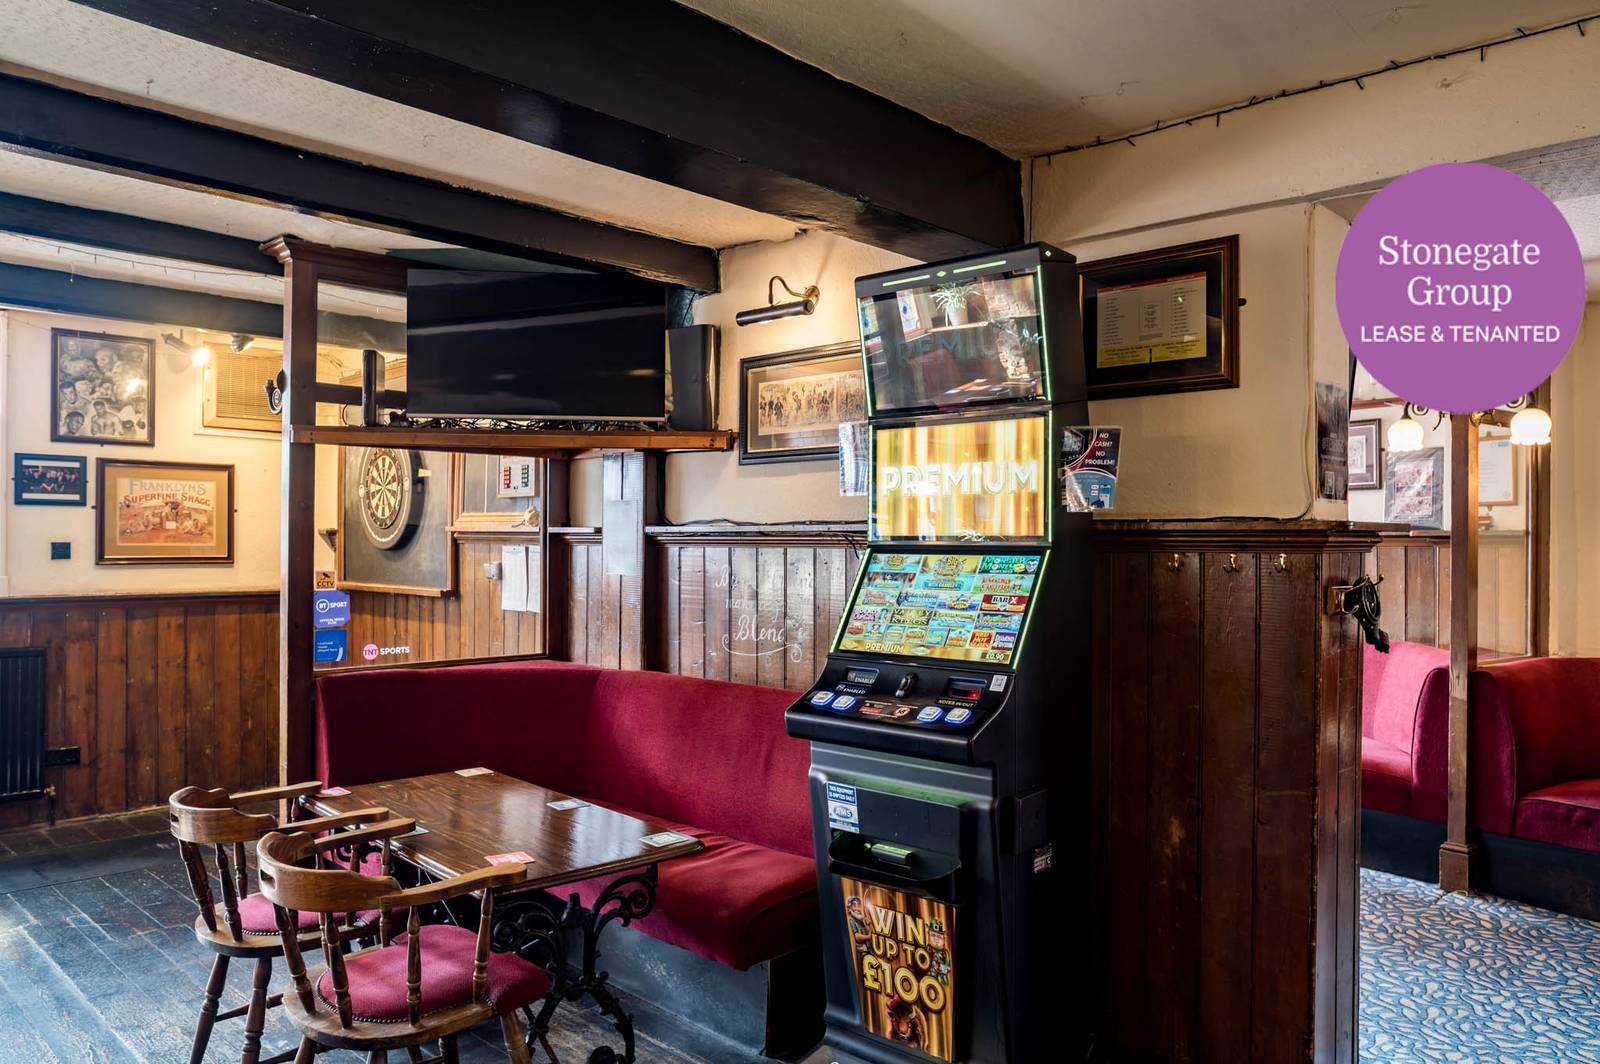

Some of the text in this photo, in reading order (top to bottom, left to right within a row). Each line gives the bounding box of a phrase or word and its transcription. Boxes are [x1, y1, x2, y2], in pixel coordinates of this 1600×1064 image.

[1084, 458, 1115, 466] PROBLEM!
[880, 459, 1039, 497] PREMIUM
[123, 492, 178, 505] SUPERFINE
[329, 601, 347, 609] SPORT
[364, 646, 410, 656] TNT SPORTS
[864, 642, 904, 653] PREMIUM
[870, 905, 926, 947] WIN
[871, 933, 931, 971] UP TO
[862, 954, 946, 1012] £100
